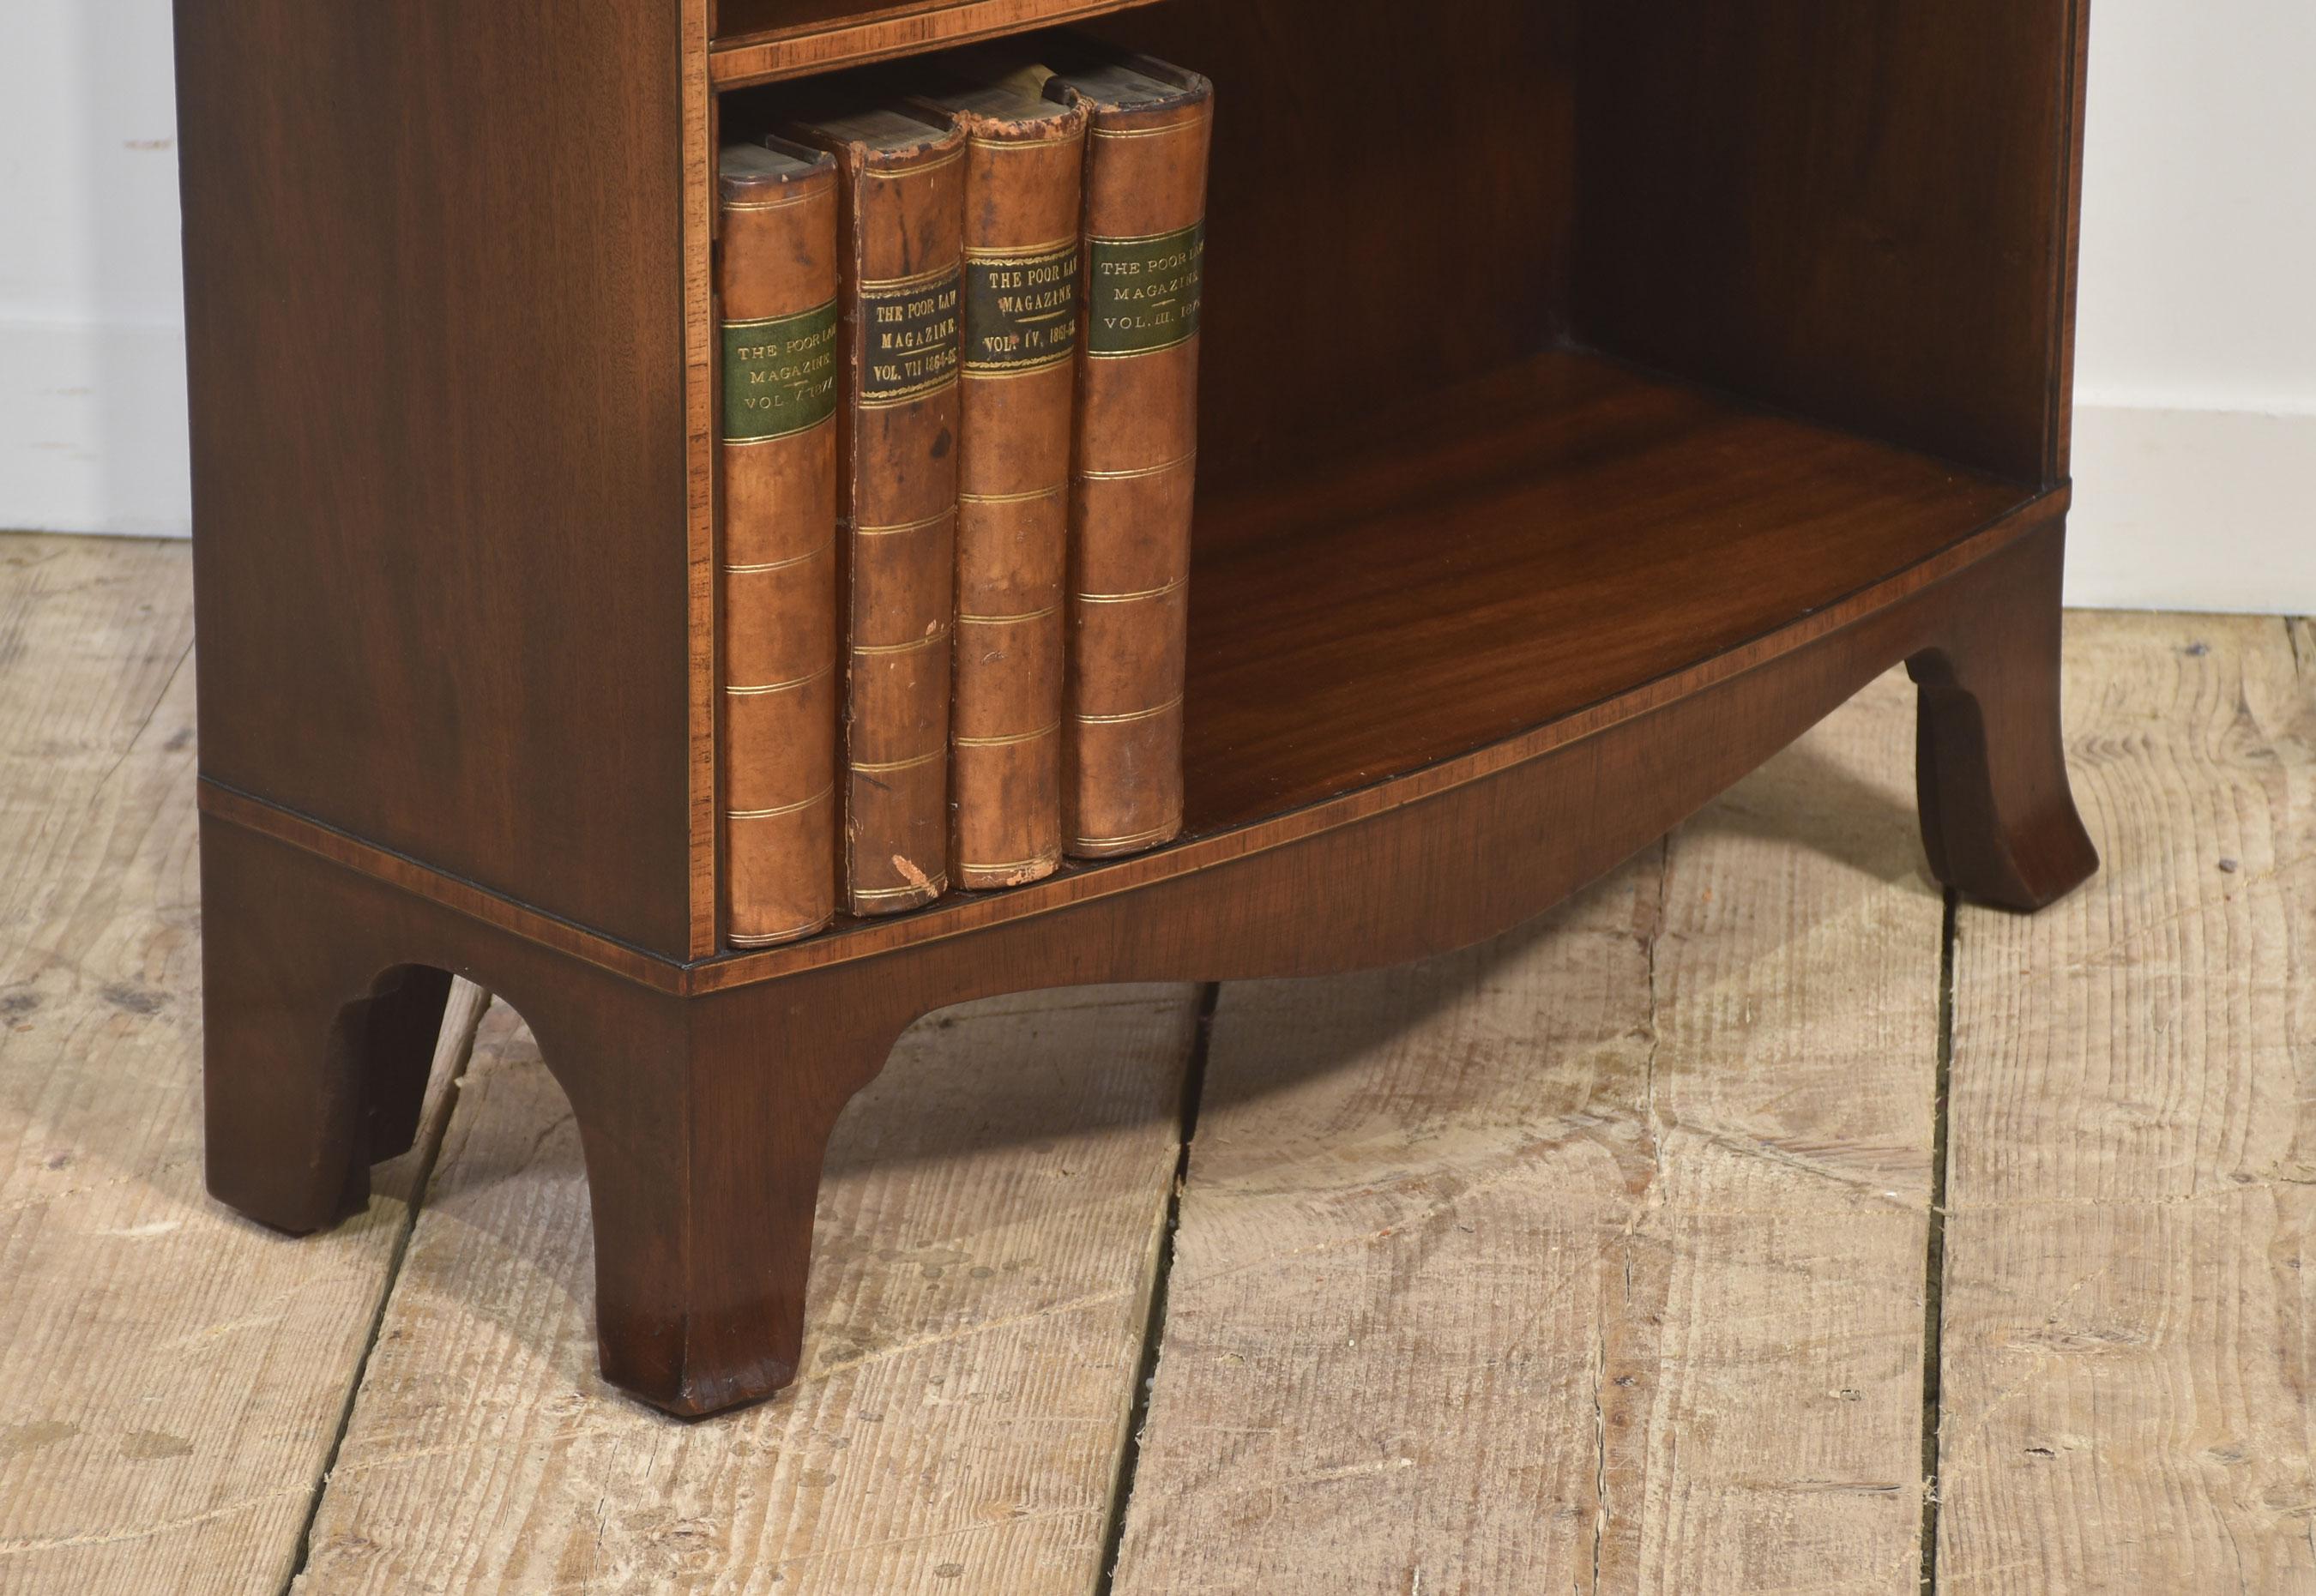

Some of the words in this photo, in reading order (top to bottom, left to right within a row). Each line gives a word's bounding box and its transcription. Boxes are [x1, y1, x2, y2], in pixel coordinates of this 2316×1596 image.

[1101, 262, 1140, 274] THE
[1148, 252, 1186, 273] POOR
[989, 271, 1022, 288] THE
[1028, 265, 1059, 286] POOR
[1113, 269, 1198, 300] MAGAZINE
[877, 305, 903, 322] THE
[908, 298, 934, 319] POOR
[938, 289, 956, 310] LAW
[1002, 284, 1071, 313] MAGAZINE
[1104, 316, 1151, 329] VOL.
[738, 344, 777, 360] THE
[787, 334, 820, 353] POOR
[750, 352, 830, 383] MAGAZINE
[873, 364, 902, 382] VOL.
